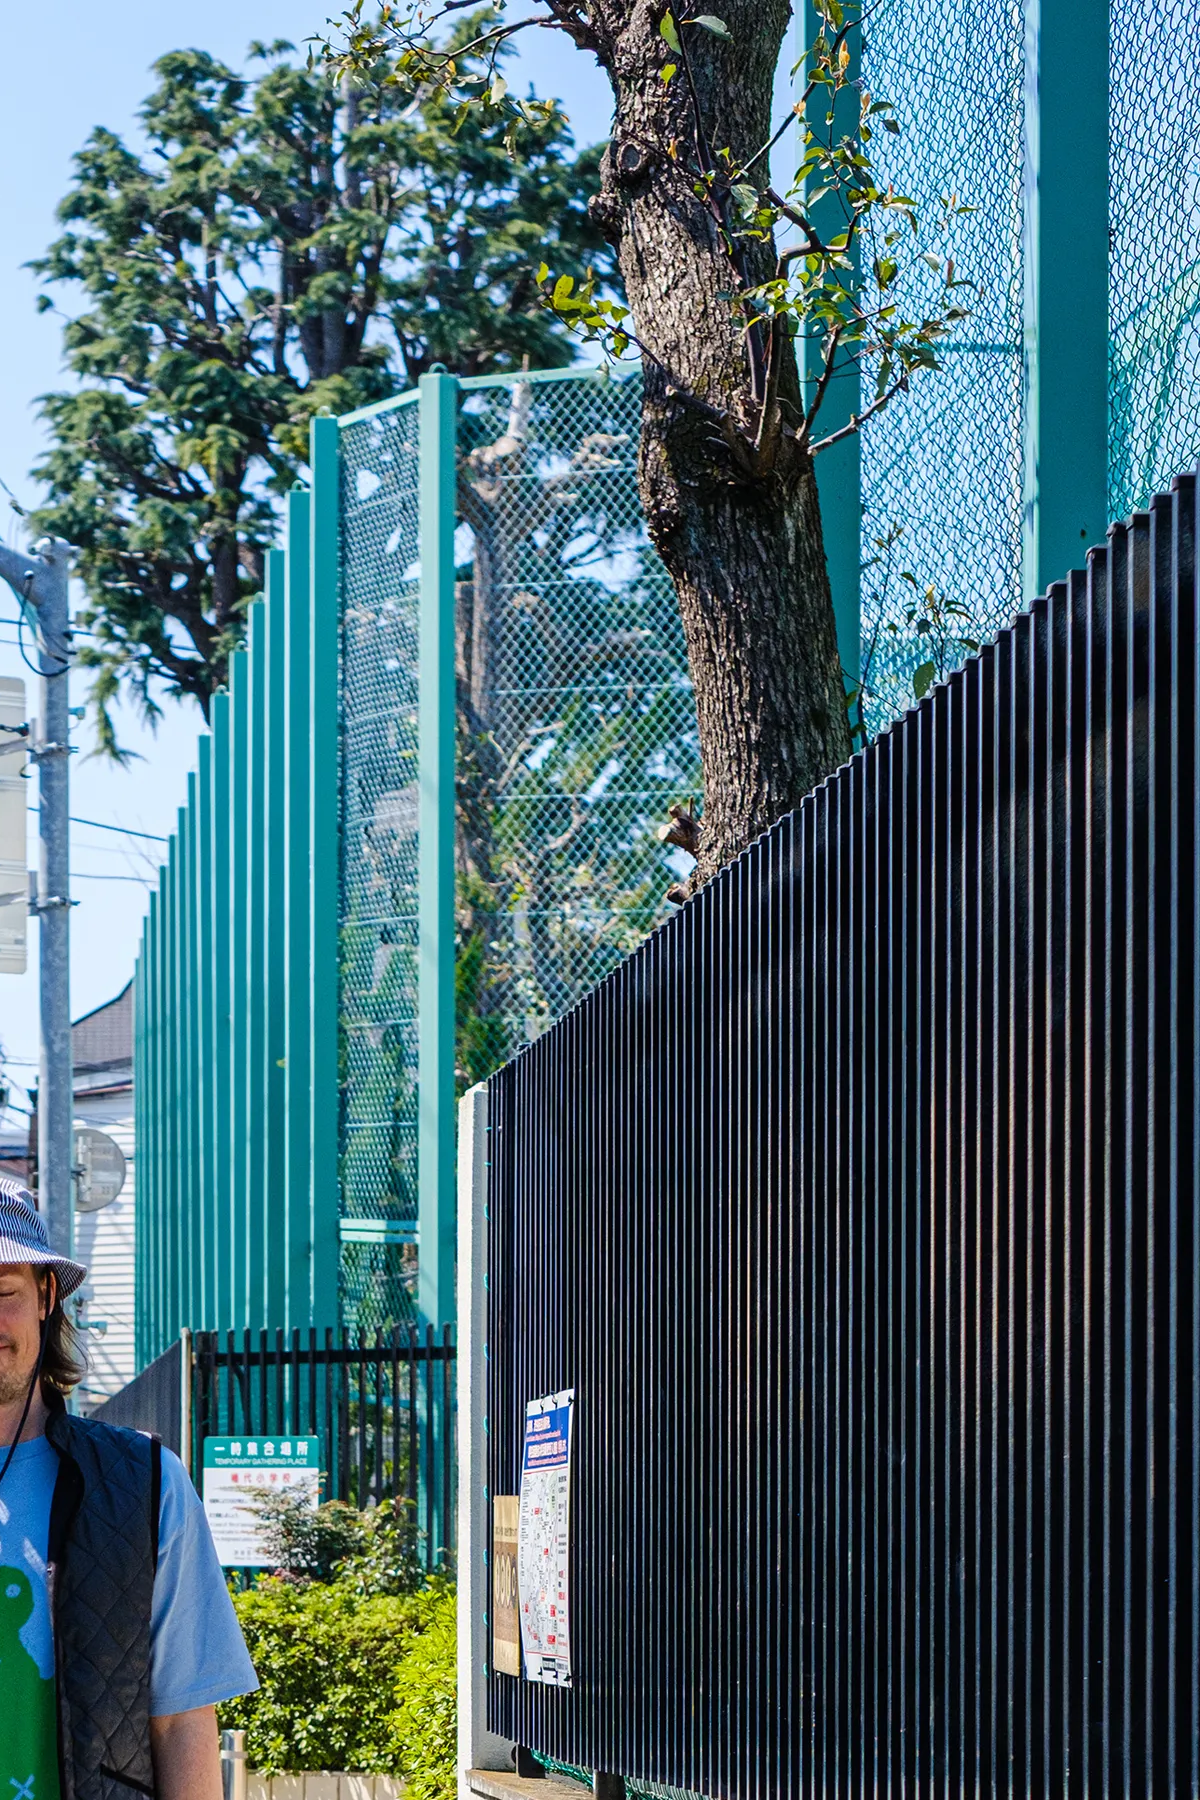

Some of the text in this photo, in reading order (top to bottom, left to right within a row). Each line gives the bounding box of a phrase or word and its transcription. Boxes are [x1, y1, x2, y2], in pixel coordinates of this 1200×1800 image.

[214, 1441, 309, 1456] 一時集合場所
[214, 1457, 308, 1465] TEMPORARY GATHERING PLACE
